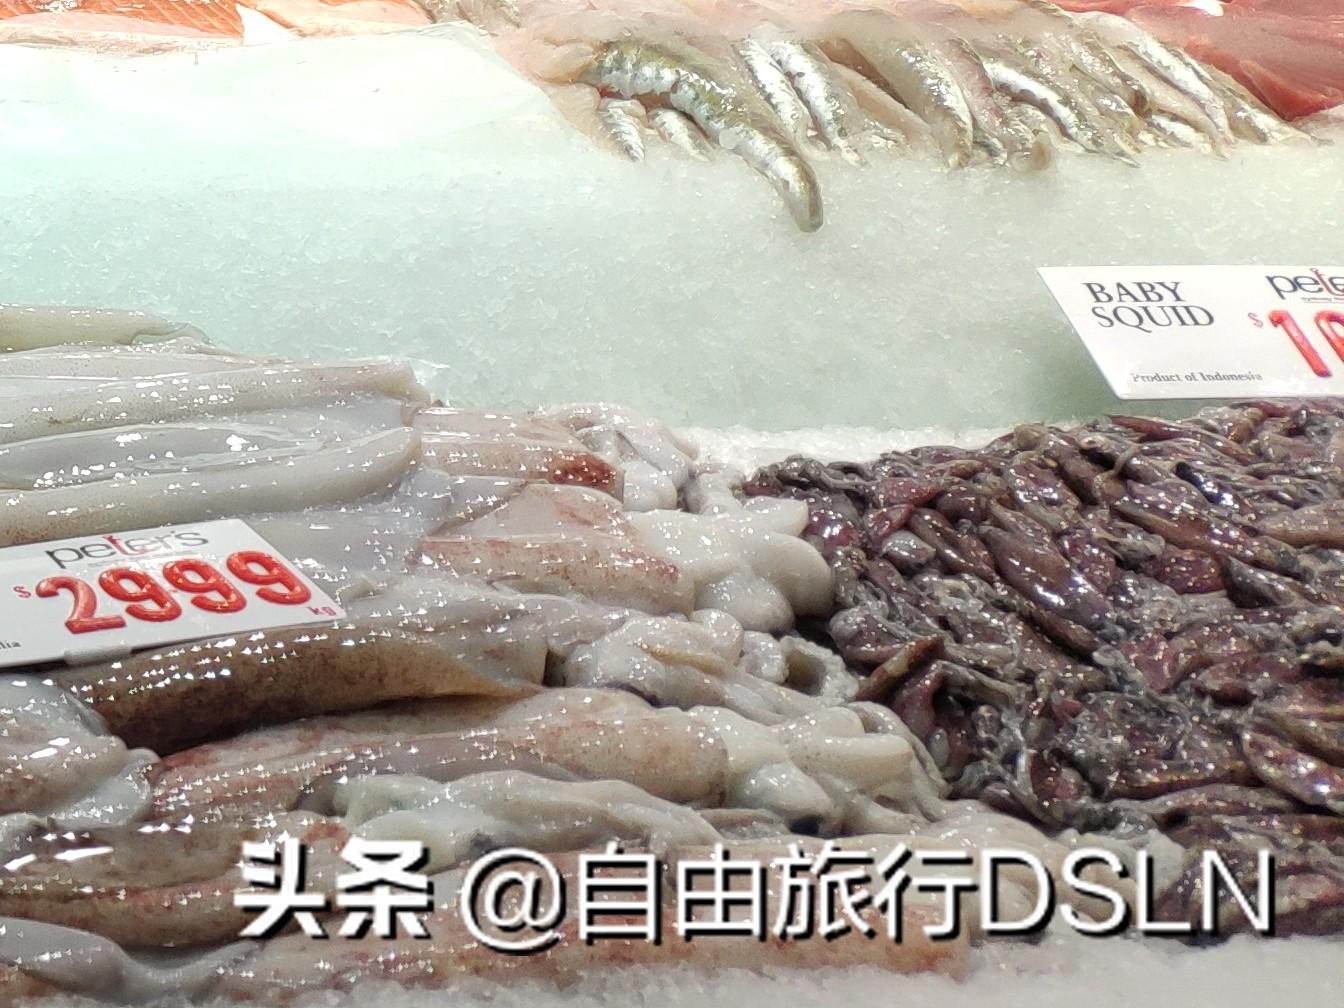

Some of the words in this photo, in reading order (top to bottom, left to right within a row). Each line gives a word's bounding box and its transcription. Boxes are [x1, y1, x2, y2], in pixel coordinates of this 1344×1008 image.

[1081, 281, 1188, 304] BABY
[1091, 305, 1216, 333] SQUID
[1131, 372, 1182, 383] Product
[1184, 372, 1199, 382] of
